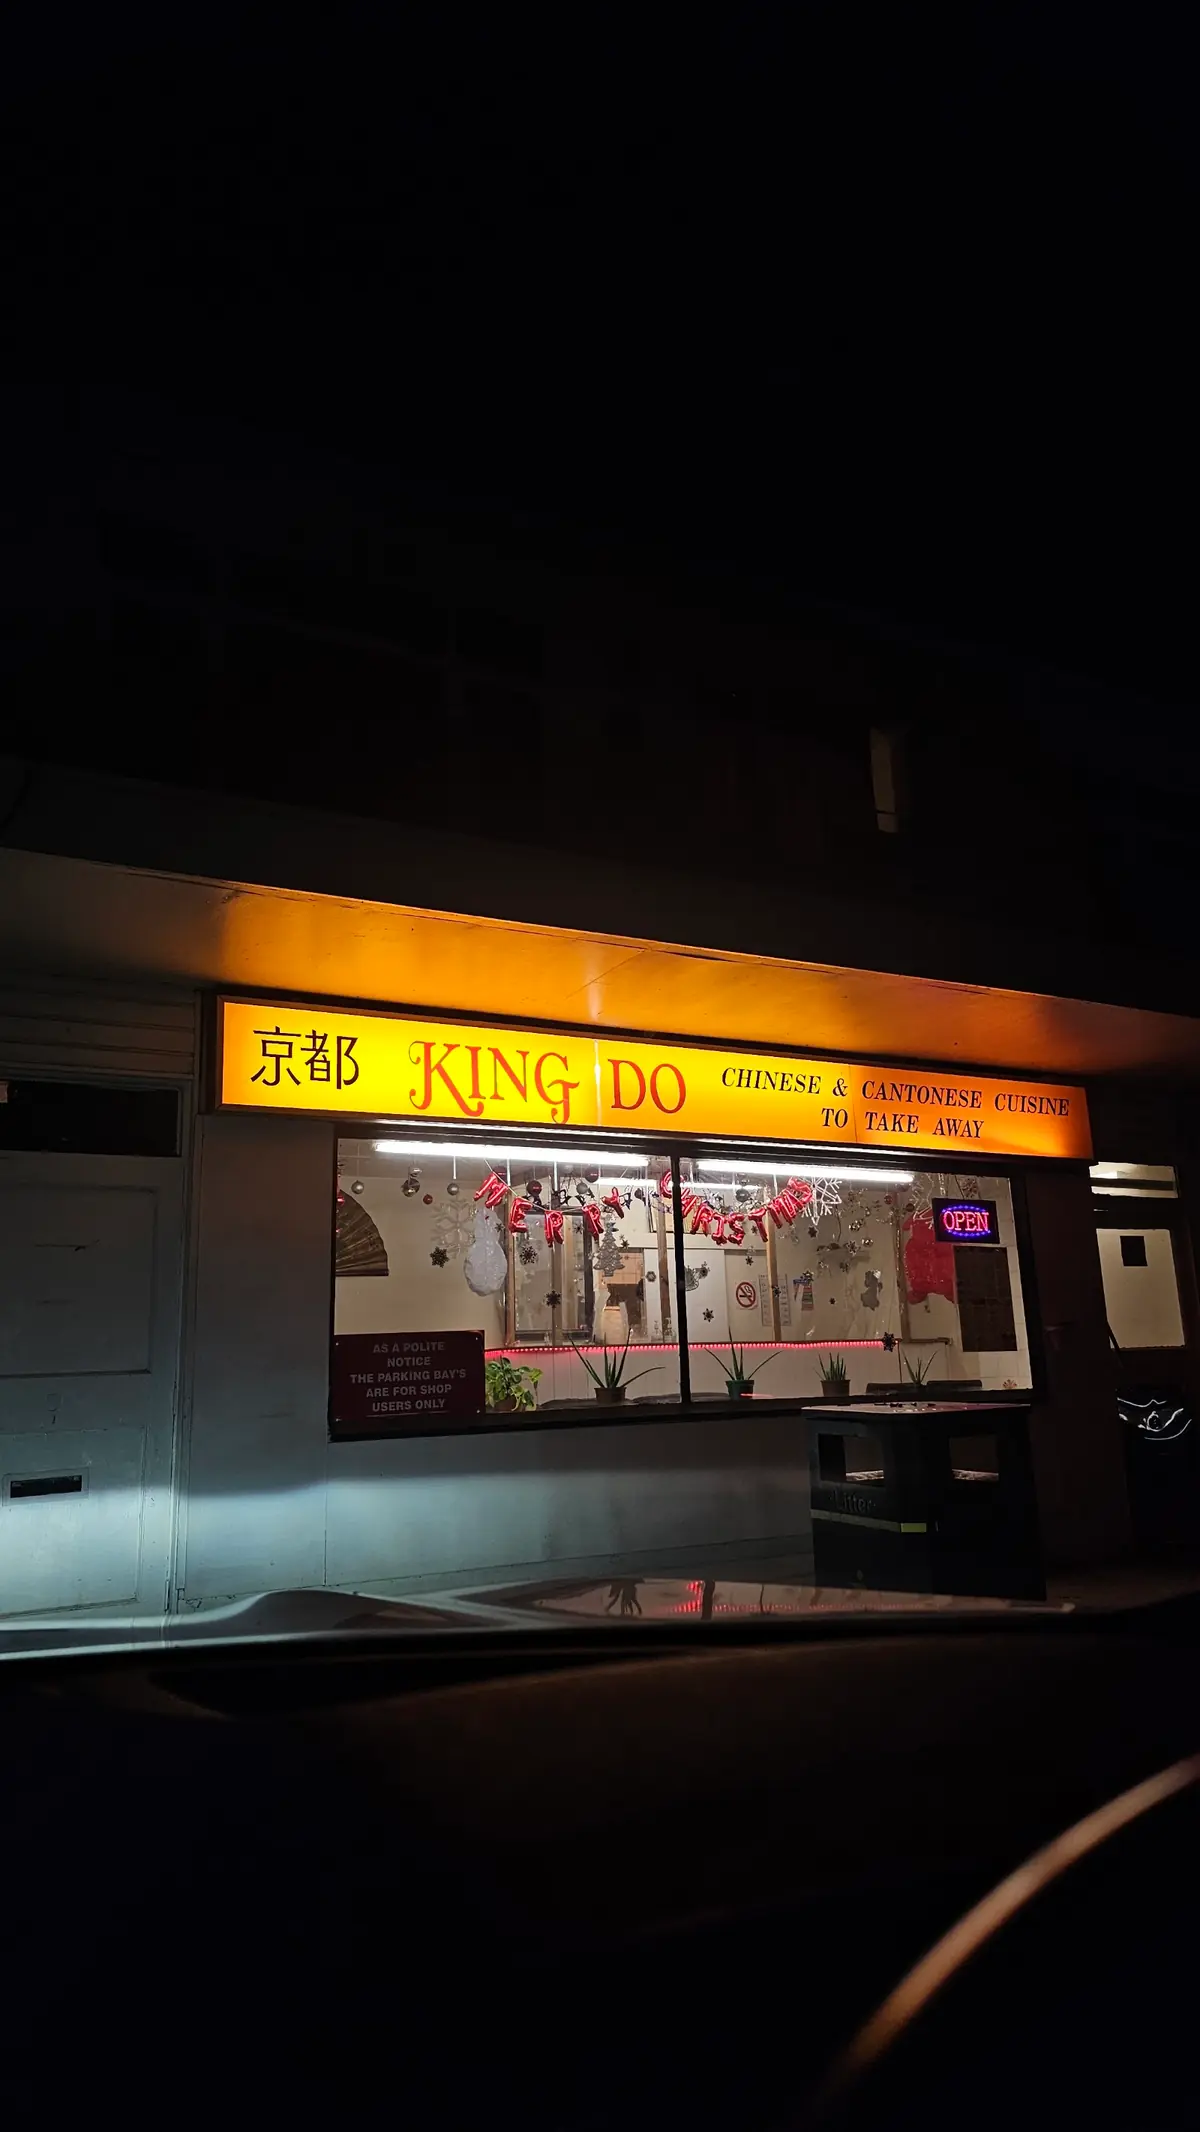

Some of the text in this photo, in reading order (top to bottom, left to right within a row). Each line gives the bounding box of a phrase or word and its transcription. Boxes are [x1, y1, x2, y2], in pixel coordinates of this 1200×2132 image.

[250, 1026, 360, 1090] 京都
[408, 1040, 687, 1125] KING DO
[721, 1067, 1070, 1117] CHINESE & CANTONESE CUISINE
[821, 1107, 985, 1139] TO TAKE AWAY
[942, 1210, 989, 1232] OPEN
[373, 1341, 446, 1354] AS A POLITE
[387, 1356, 432, 1368] NOTICE
[350, 1368, 467, 1384] THE PARKING BAY'S
[366, 1383, 452, 1398] ARE FOR SHOP
[372, 1398, 446, 1412] USERS ONLY
